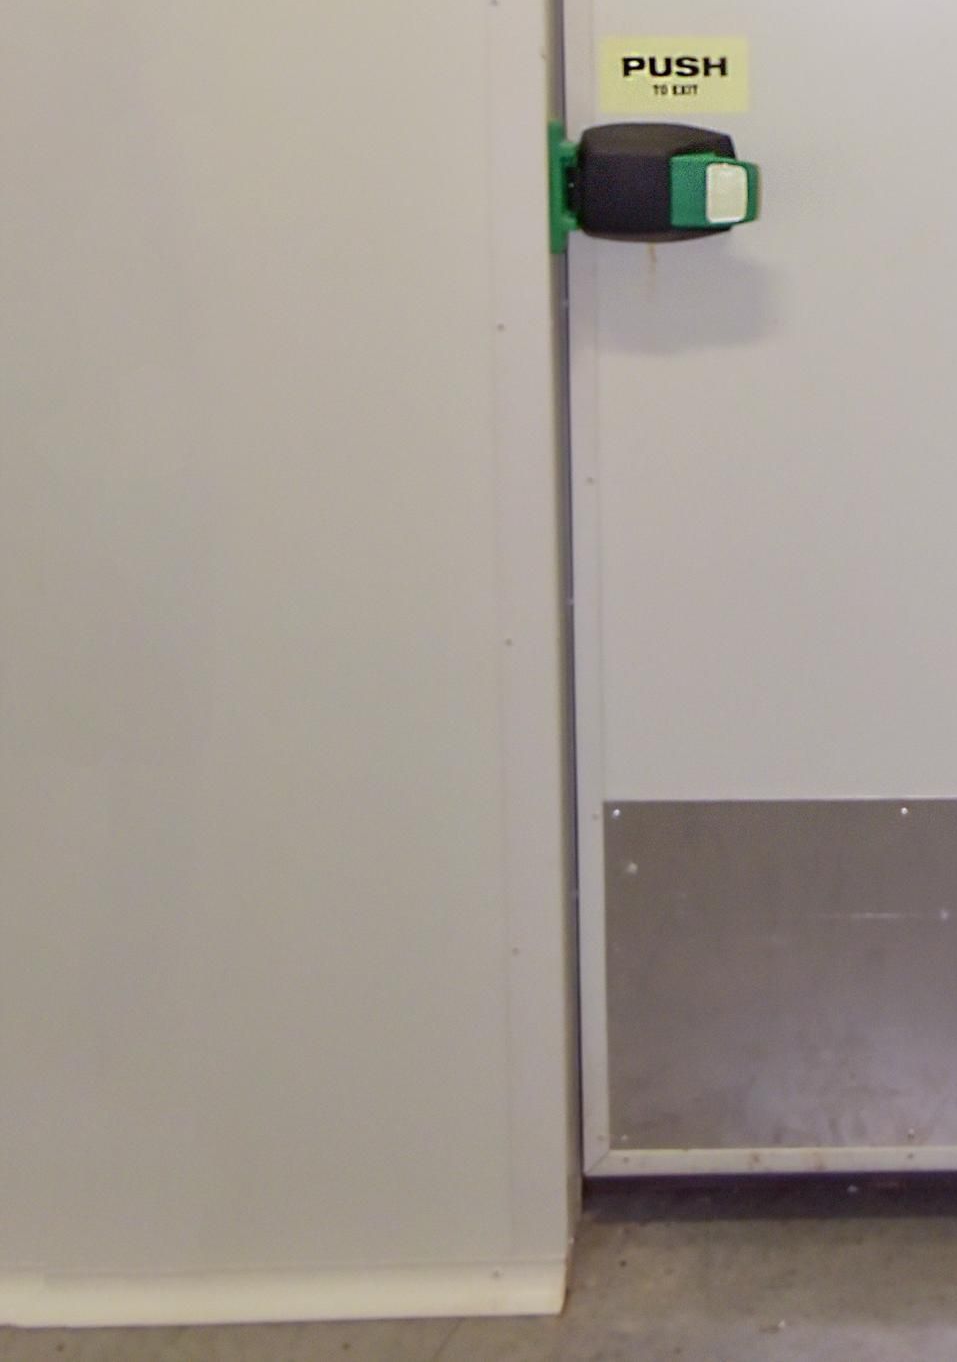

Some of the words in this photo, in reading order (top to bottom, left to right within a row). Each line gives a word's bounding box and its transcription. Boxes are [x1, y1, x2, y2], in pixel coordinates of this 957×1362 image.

[622, 56, 728, 78] PUSH
[653, 84, 668, 95] TO
[672, 84, 698, 95] EXIT
